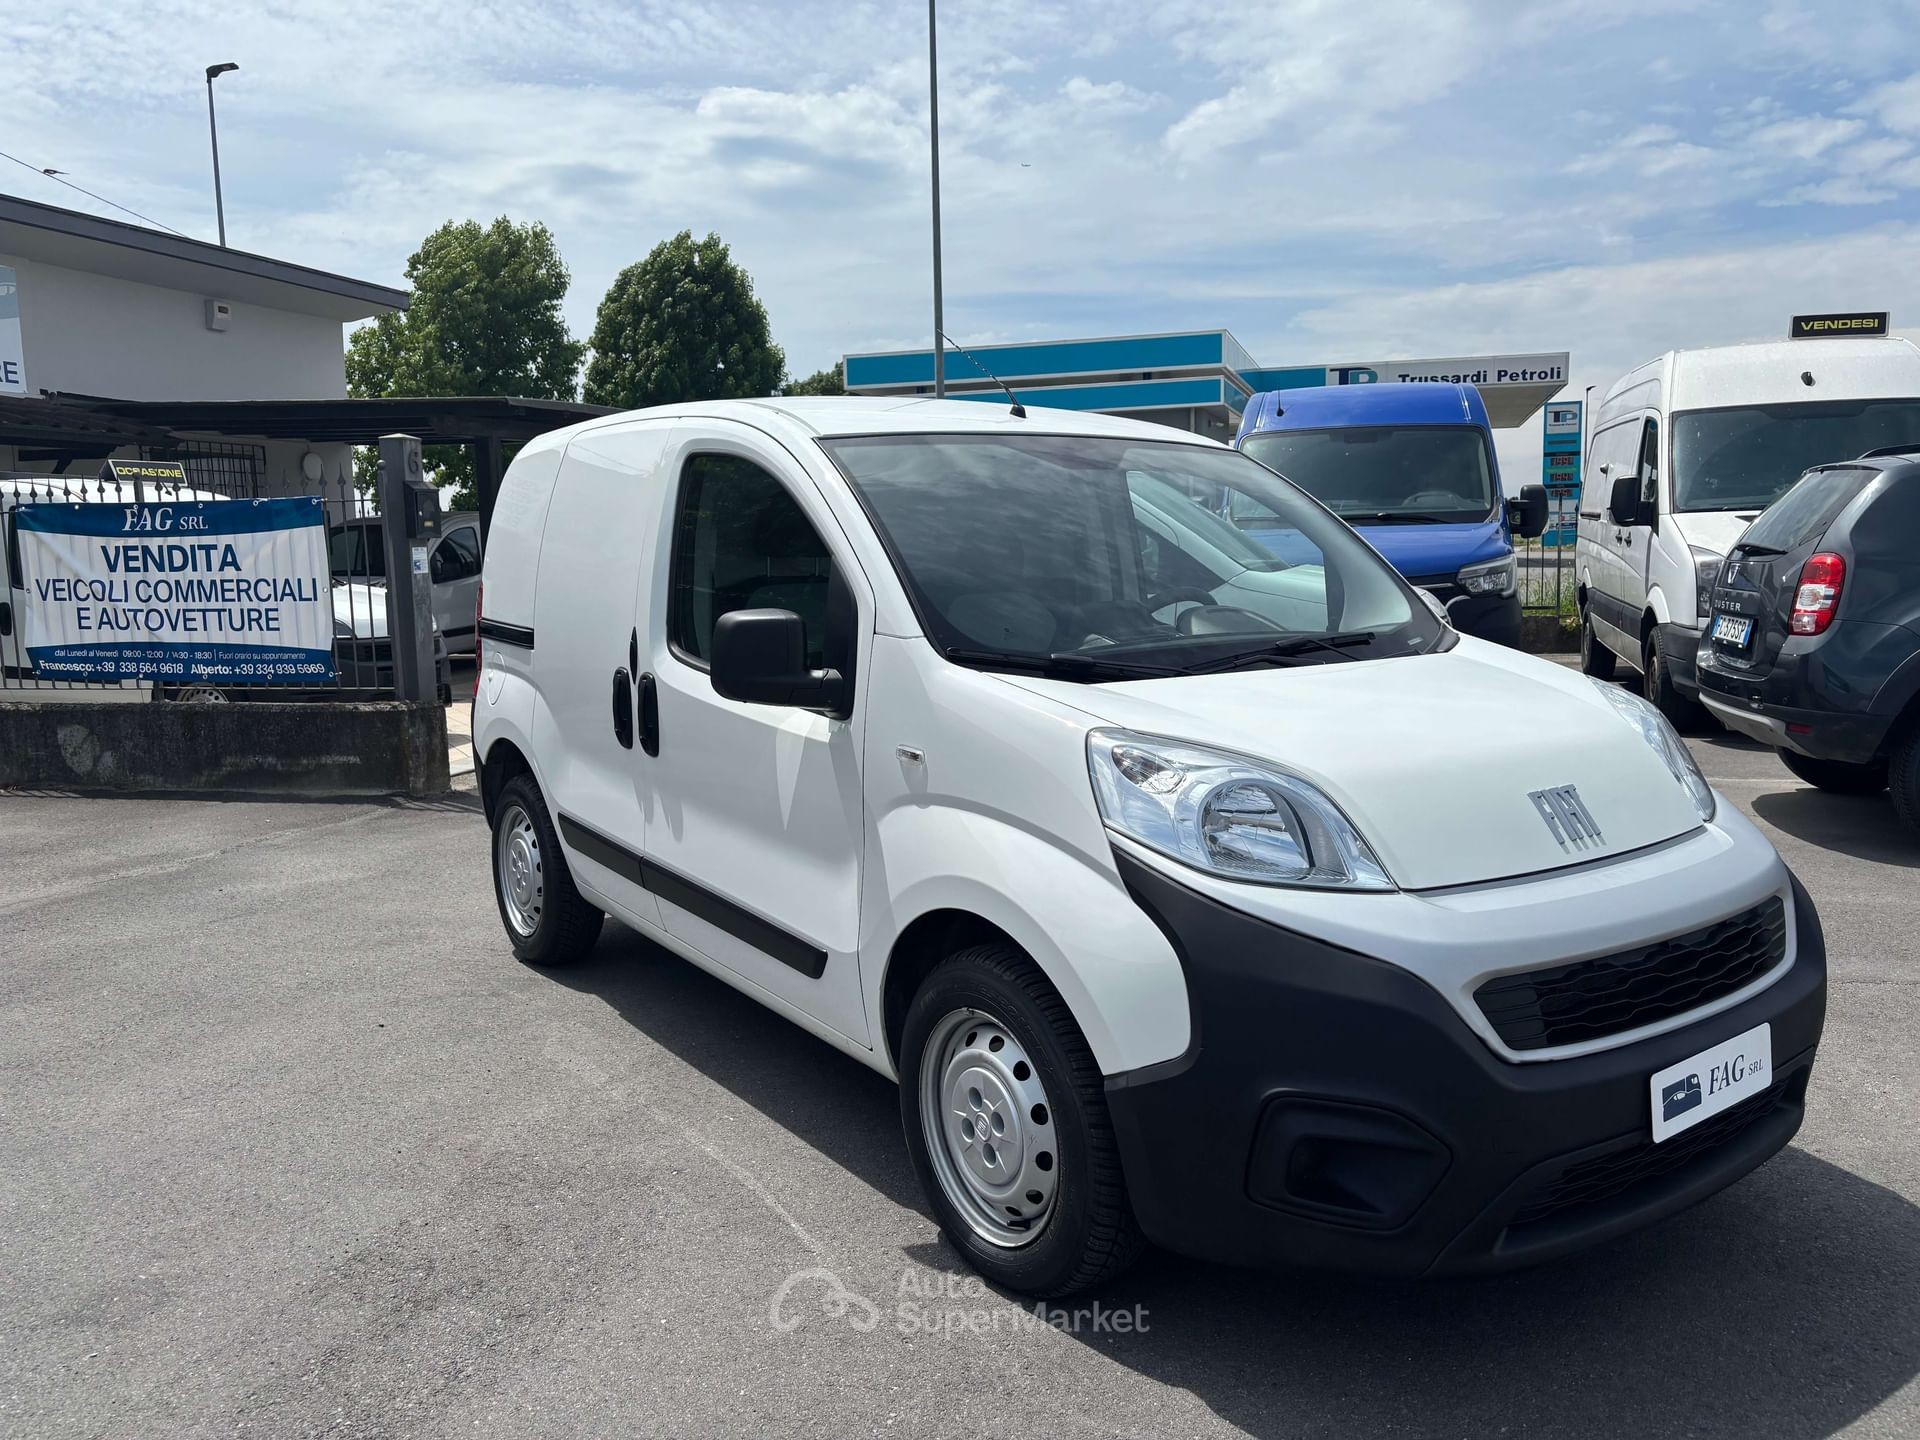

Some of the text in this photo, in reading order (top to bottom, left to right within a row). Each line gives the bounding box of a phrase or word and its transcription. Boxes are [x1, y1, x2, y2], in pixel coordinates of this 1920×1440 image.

[1800, 318, 1879, 331] VENDESI
[1398, 371, 1488, 384] Trussardi
[1497, 366, 1562, 382] Petroli
[122, 507, 209, 531] FAG SRL
[101, 543, 242, 573] VENDITA
[35, 578, 319, 603] VEICOLI COMMERCIALI
[77, 607, 281, 632] E AUTOVETTURE
[39, 660, 95, 672] Francesco:
[95, 661, 115, 672] +39
[119, 662, 138, 673] 338
[138, 662, 158, 673] 564
[159, 662, 184, 673] 9618
[190, 663, 233, 674] Alberto:
[233, 663, 254, 674] +39
[255, 663, 274, 674] 334
[275, 663, 296, 674] 939
[54, 649, 66, 657] dal
[88, 649, 95, 657] al
[122, 650, 142, 658] 09:00
[146, 650, 164, 658] 12:00
[194, 651, 213, 659] 18:30
[218, 651, 234, 659] Fuori
[234, 651, 251, 659] orario
[261, 652, 306, 661] appuntamento
[1526, 783, 1602, 845] FIAT
[1707, 1054, 1764, 1096] FAG SRL
